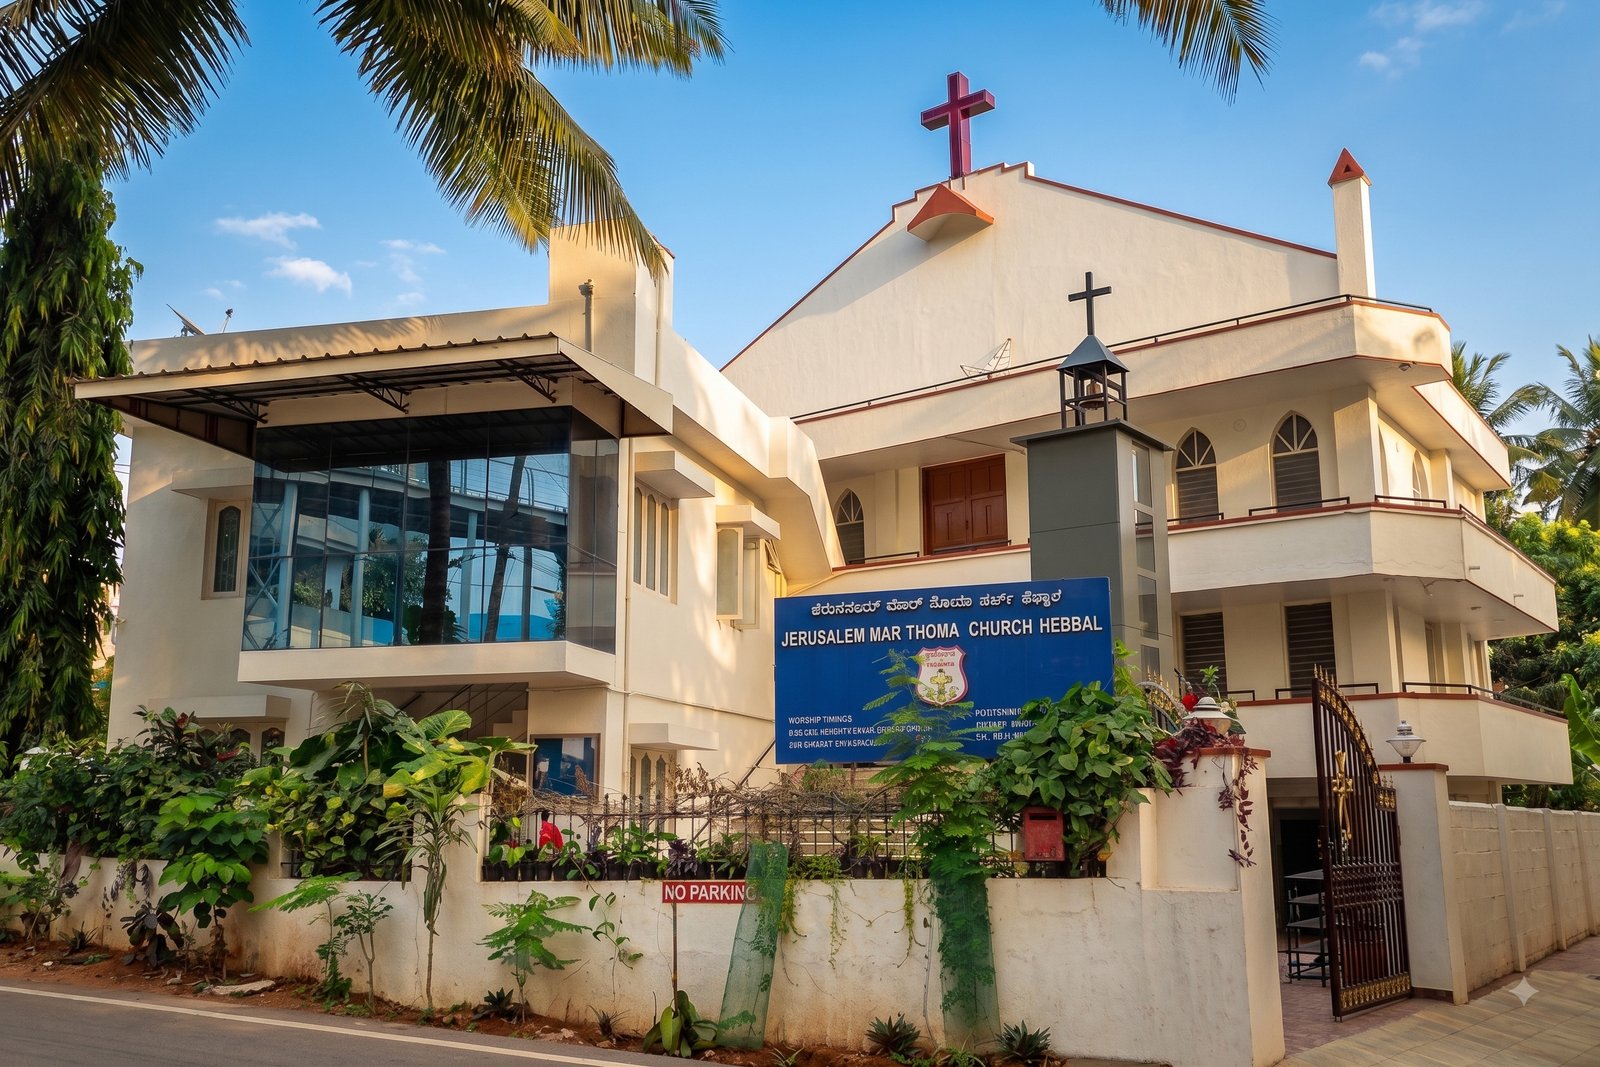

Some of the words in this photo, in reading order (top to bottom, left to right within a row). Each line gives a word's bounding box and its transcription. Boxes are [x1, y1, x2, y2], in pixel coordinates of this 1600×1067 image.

[781, 627, 865, 647] JERUSALEM
[870, 626, 901, 642] MAR
[906, 622, 960, 640] THOMA
[969, 619, 1032, 637] CHURCH
[1040, 615, 1103, 633] HEBBAL
[788, 716, 821, 724] WORSHIP
[822, 715, 853, 723] TIMINGS
[664, 884, 687, 900] NO
